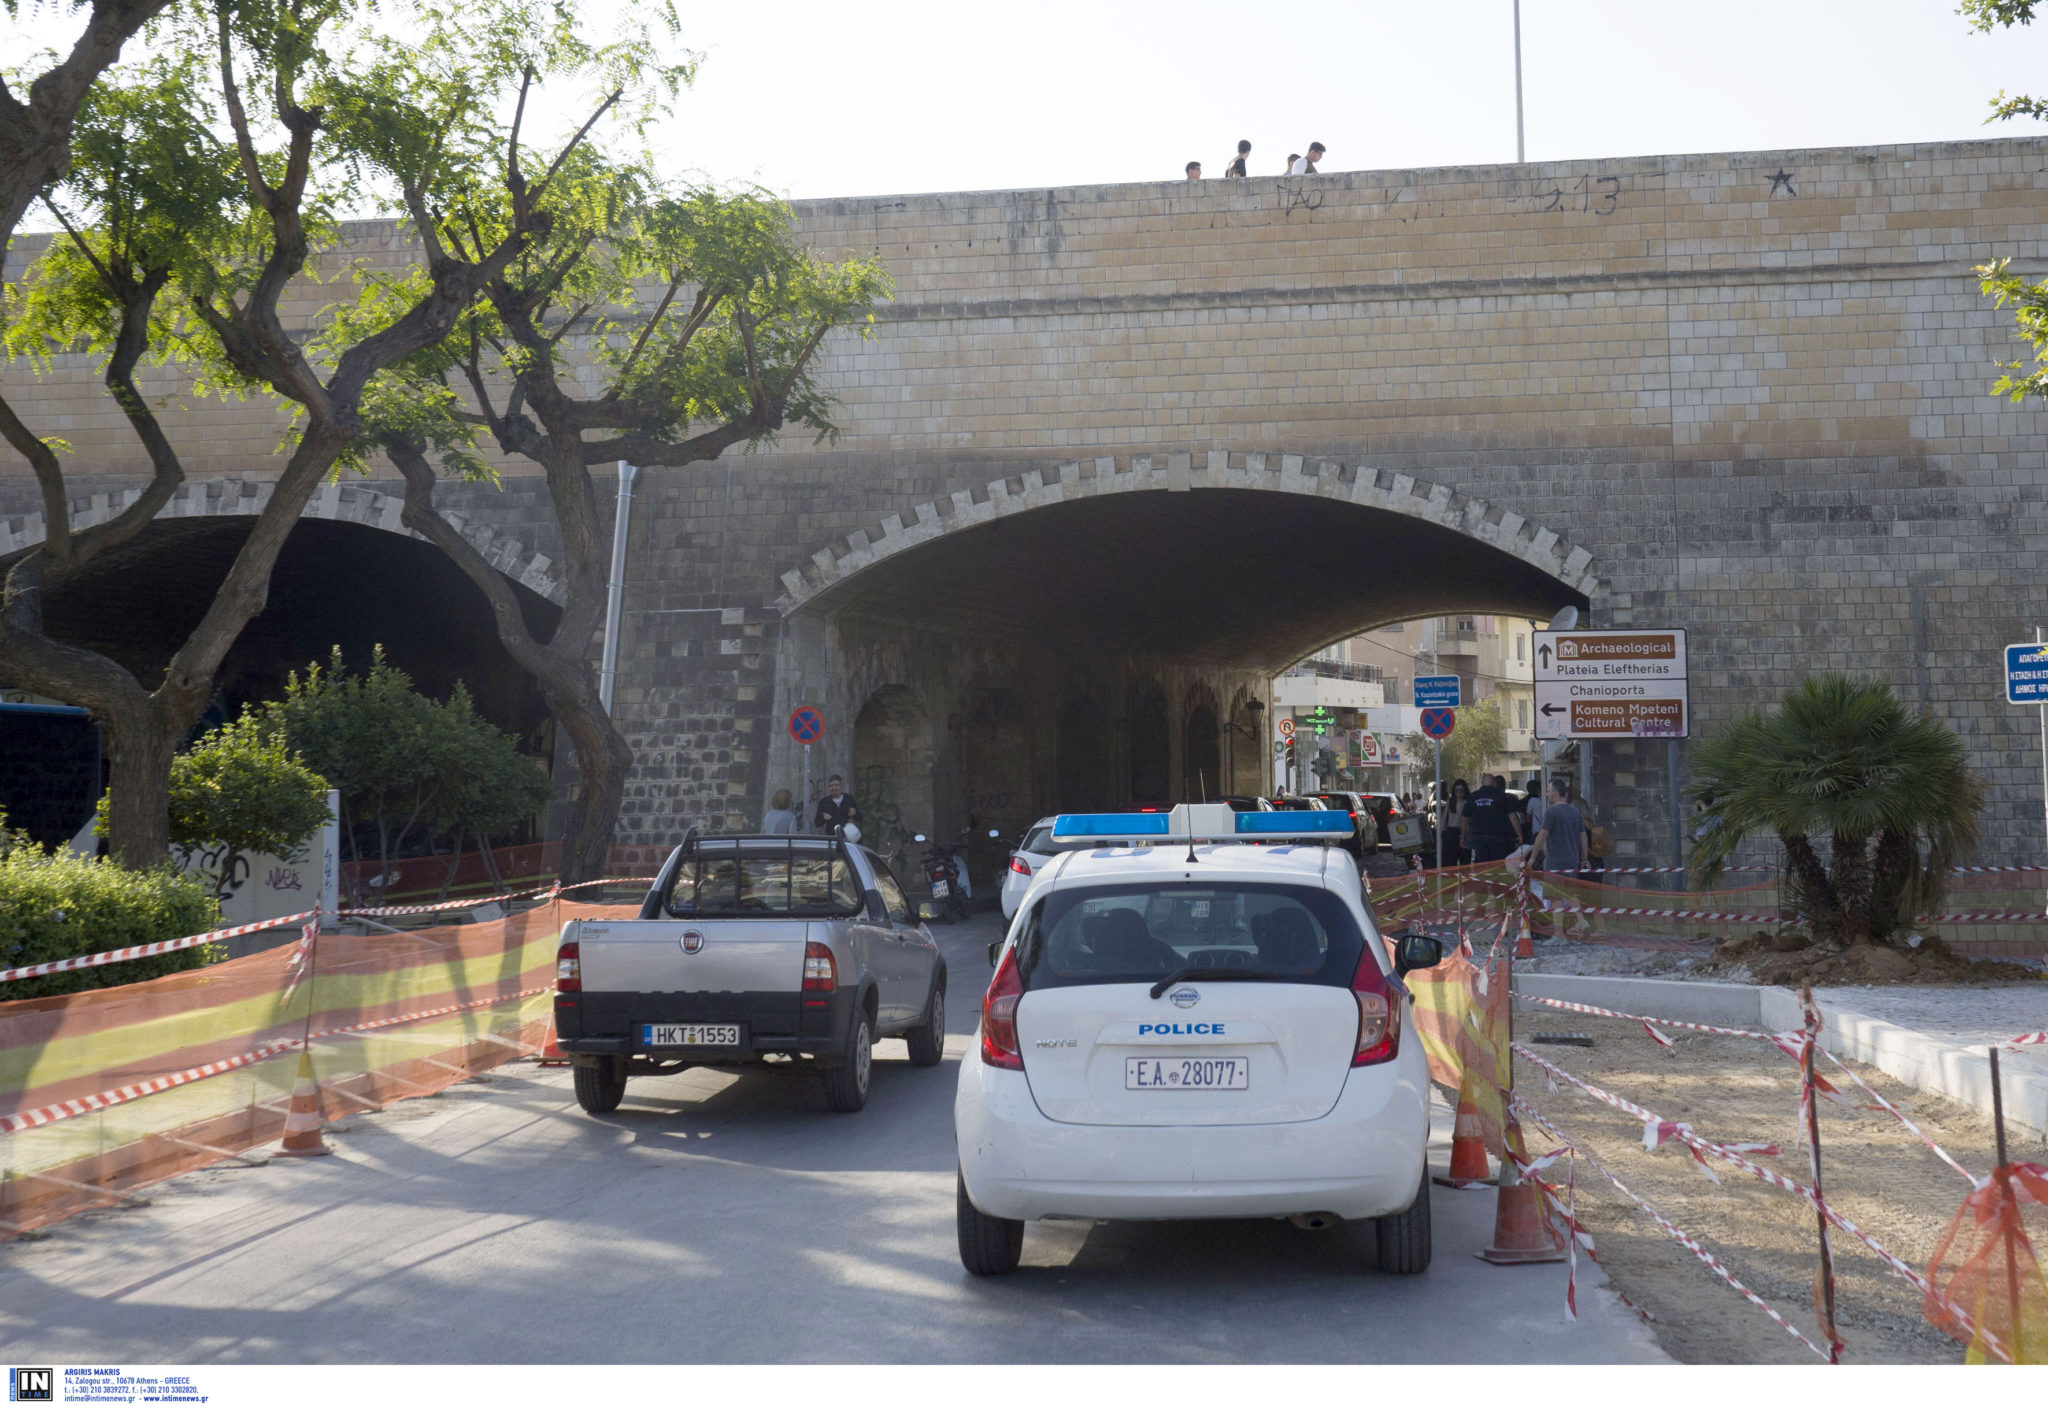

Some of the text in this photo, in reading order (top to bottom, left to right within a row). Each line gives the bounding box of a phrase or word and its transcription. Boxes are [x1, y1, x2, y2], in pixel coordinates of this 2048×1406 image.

[1581, 642, 1672, 654] Archaeological
[1557, 664, 1670, 676] Plateia Eleftherias
[1570, 685, 1645, 697] Chanioporta
[1576, 703, 1679, 716] Komeno Mpeteni
[1576, 717, 1626, 728] Cultural
[686, 937, 698, 948] FIAT
[657, 1027, 737, 1044] HKT 1553
[1139, 1023, 1226, 1036] POLICE
[1036, 1040, 1077, 1048] NOTE
[1137, 1061, 1236, 1086] E.A. 28077
